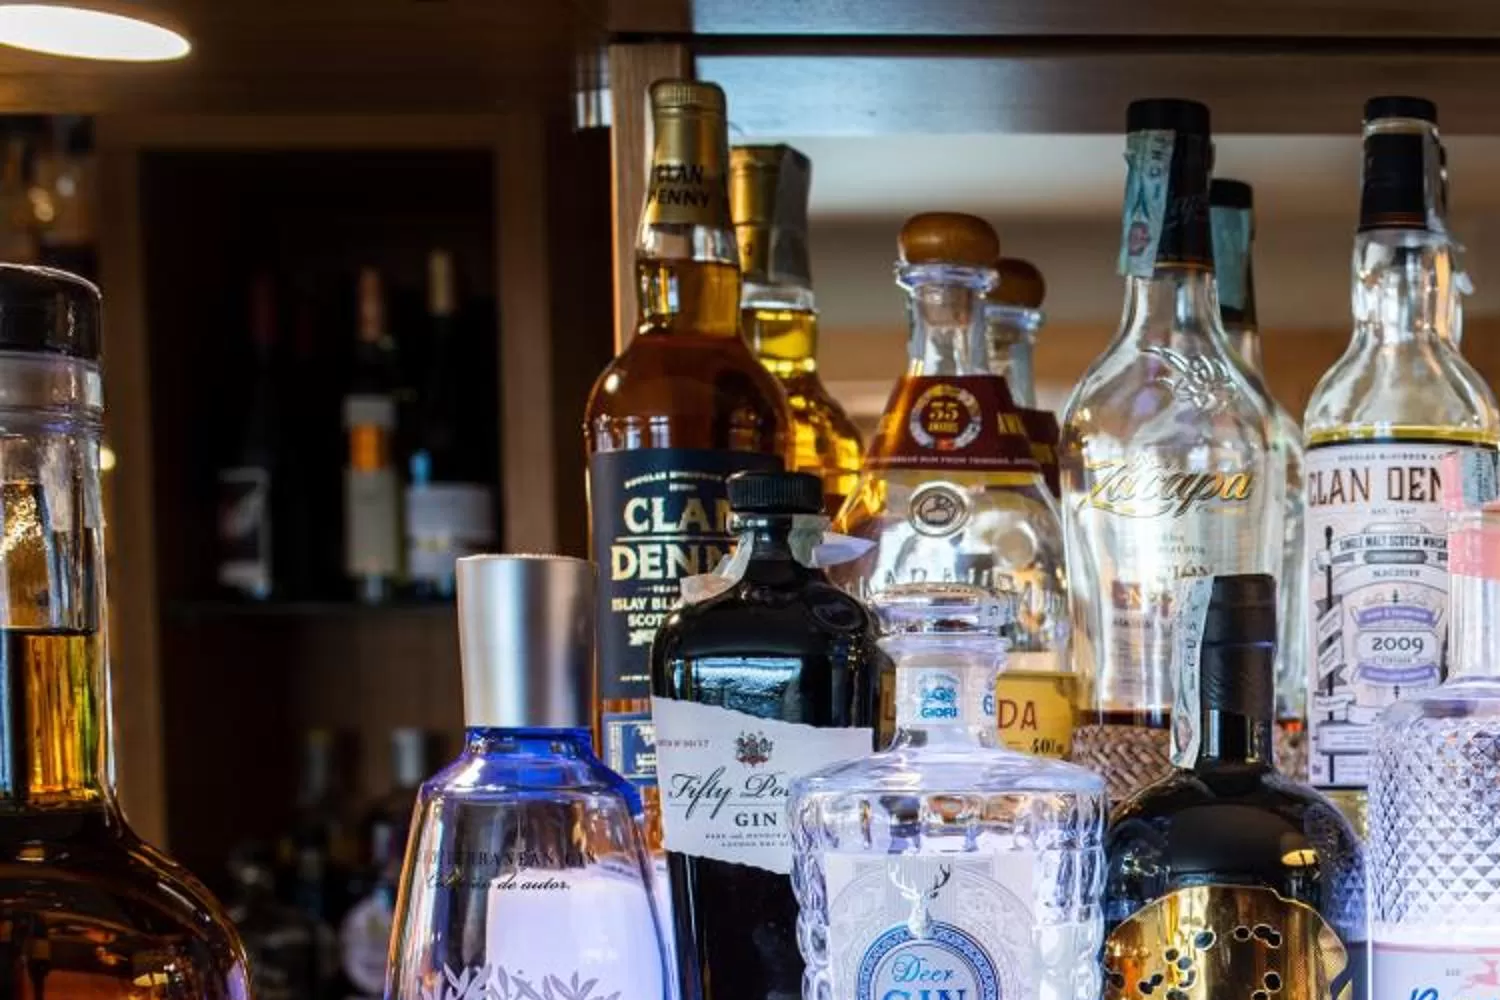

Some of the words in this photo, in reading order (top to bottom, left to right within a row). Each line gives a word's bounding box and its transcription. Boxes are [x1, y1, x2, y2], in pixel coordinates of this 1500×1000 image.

[1307, 466, 1371, 507] CLAN
[1365, 535, 1388, 549] MALT
[1389, 535, 1421, 548] SCOTCH
[1371, 636, 1425, 658] 2009
[668, 765, 732, 821] Fifty
[734, 812, 778, 827] GIN
[496, 873, 517, 891] de
[891, 953, 954, 983] Deer
